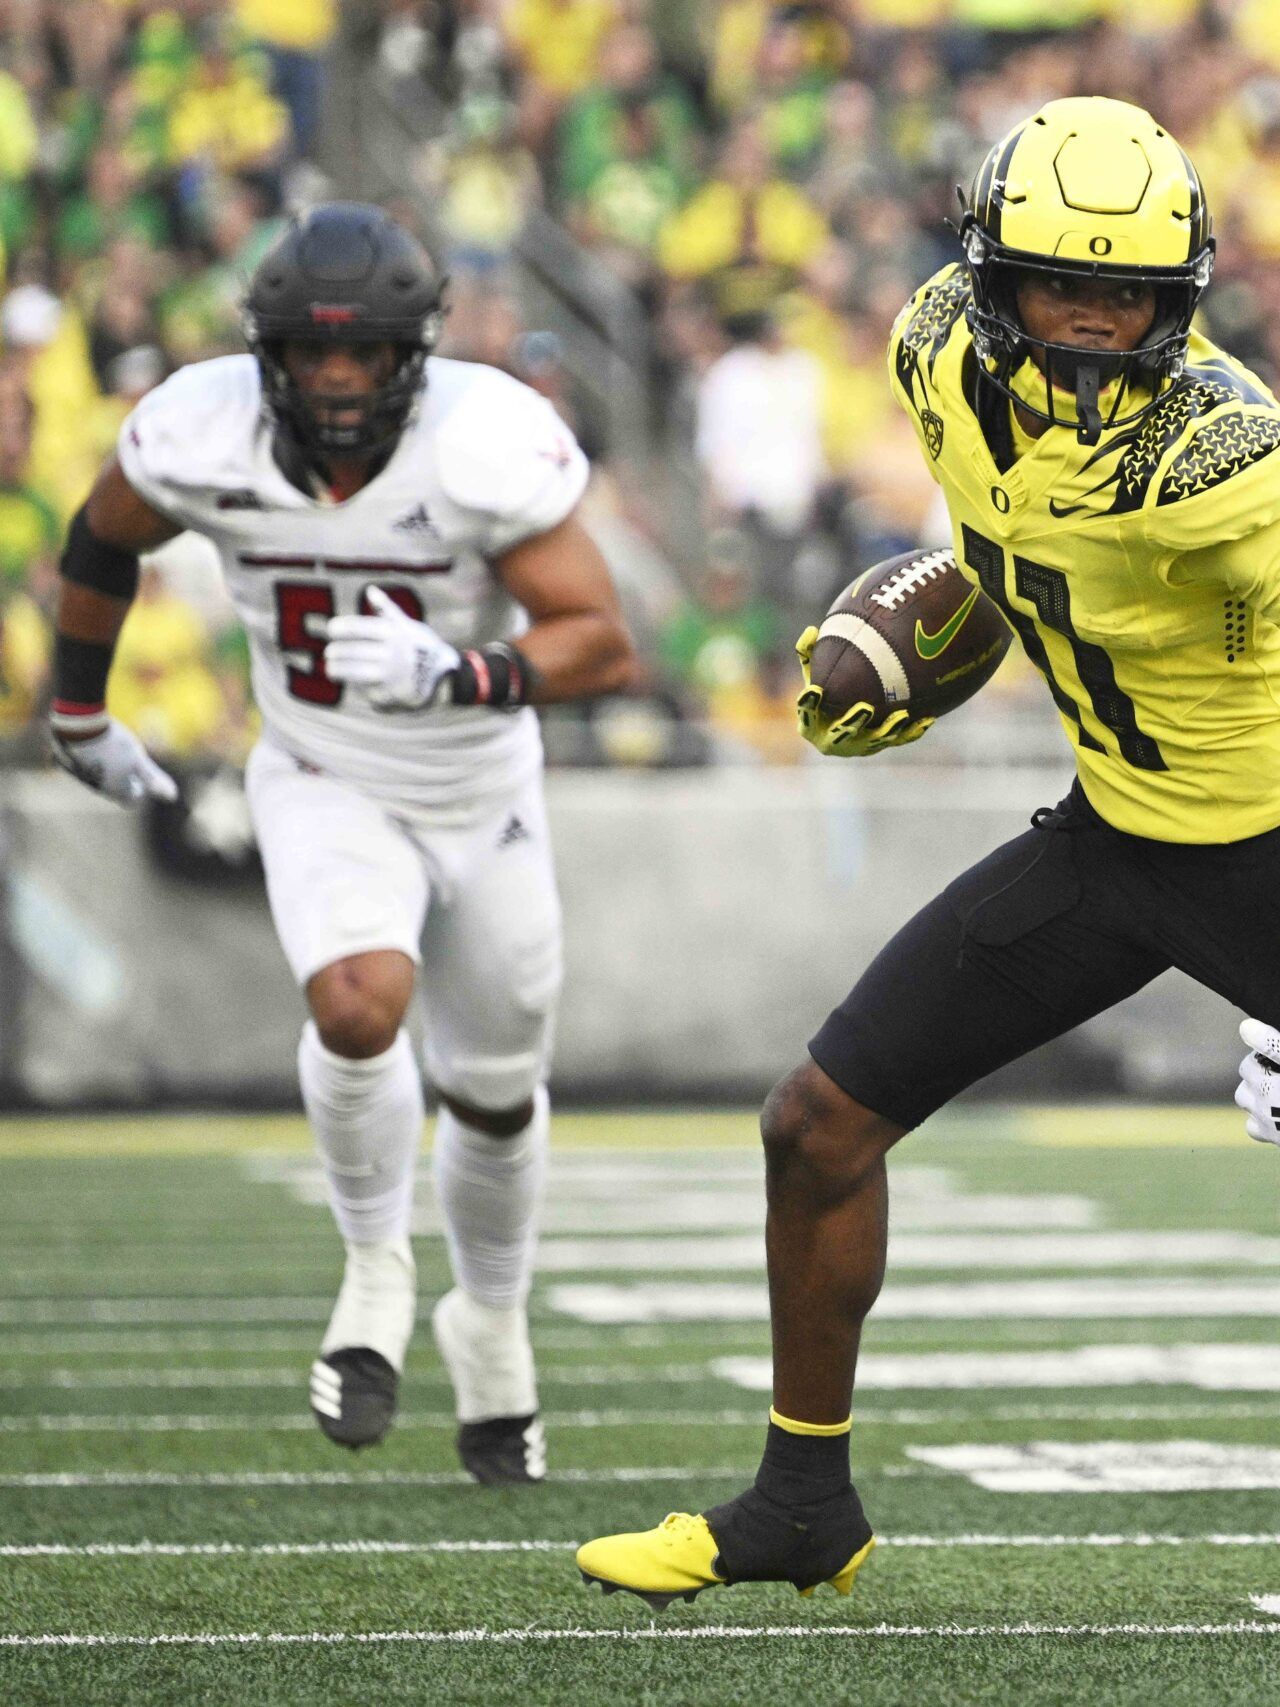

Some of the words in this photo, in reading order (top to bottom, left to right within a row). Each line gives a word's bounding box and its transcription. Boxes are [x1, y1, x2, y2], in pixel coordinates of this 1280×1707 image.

[1089, 236, 1112, 256] O
[991, 486, 1010, 514] O
[961, 522, 1170, 771] 11
